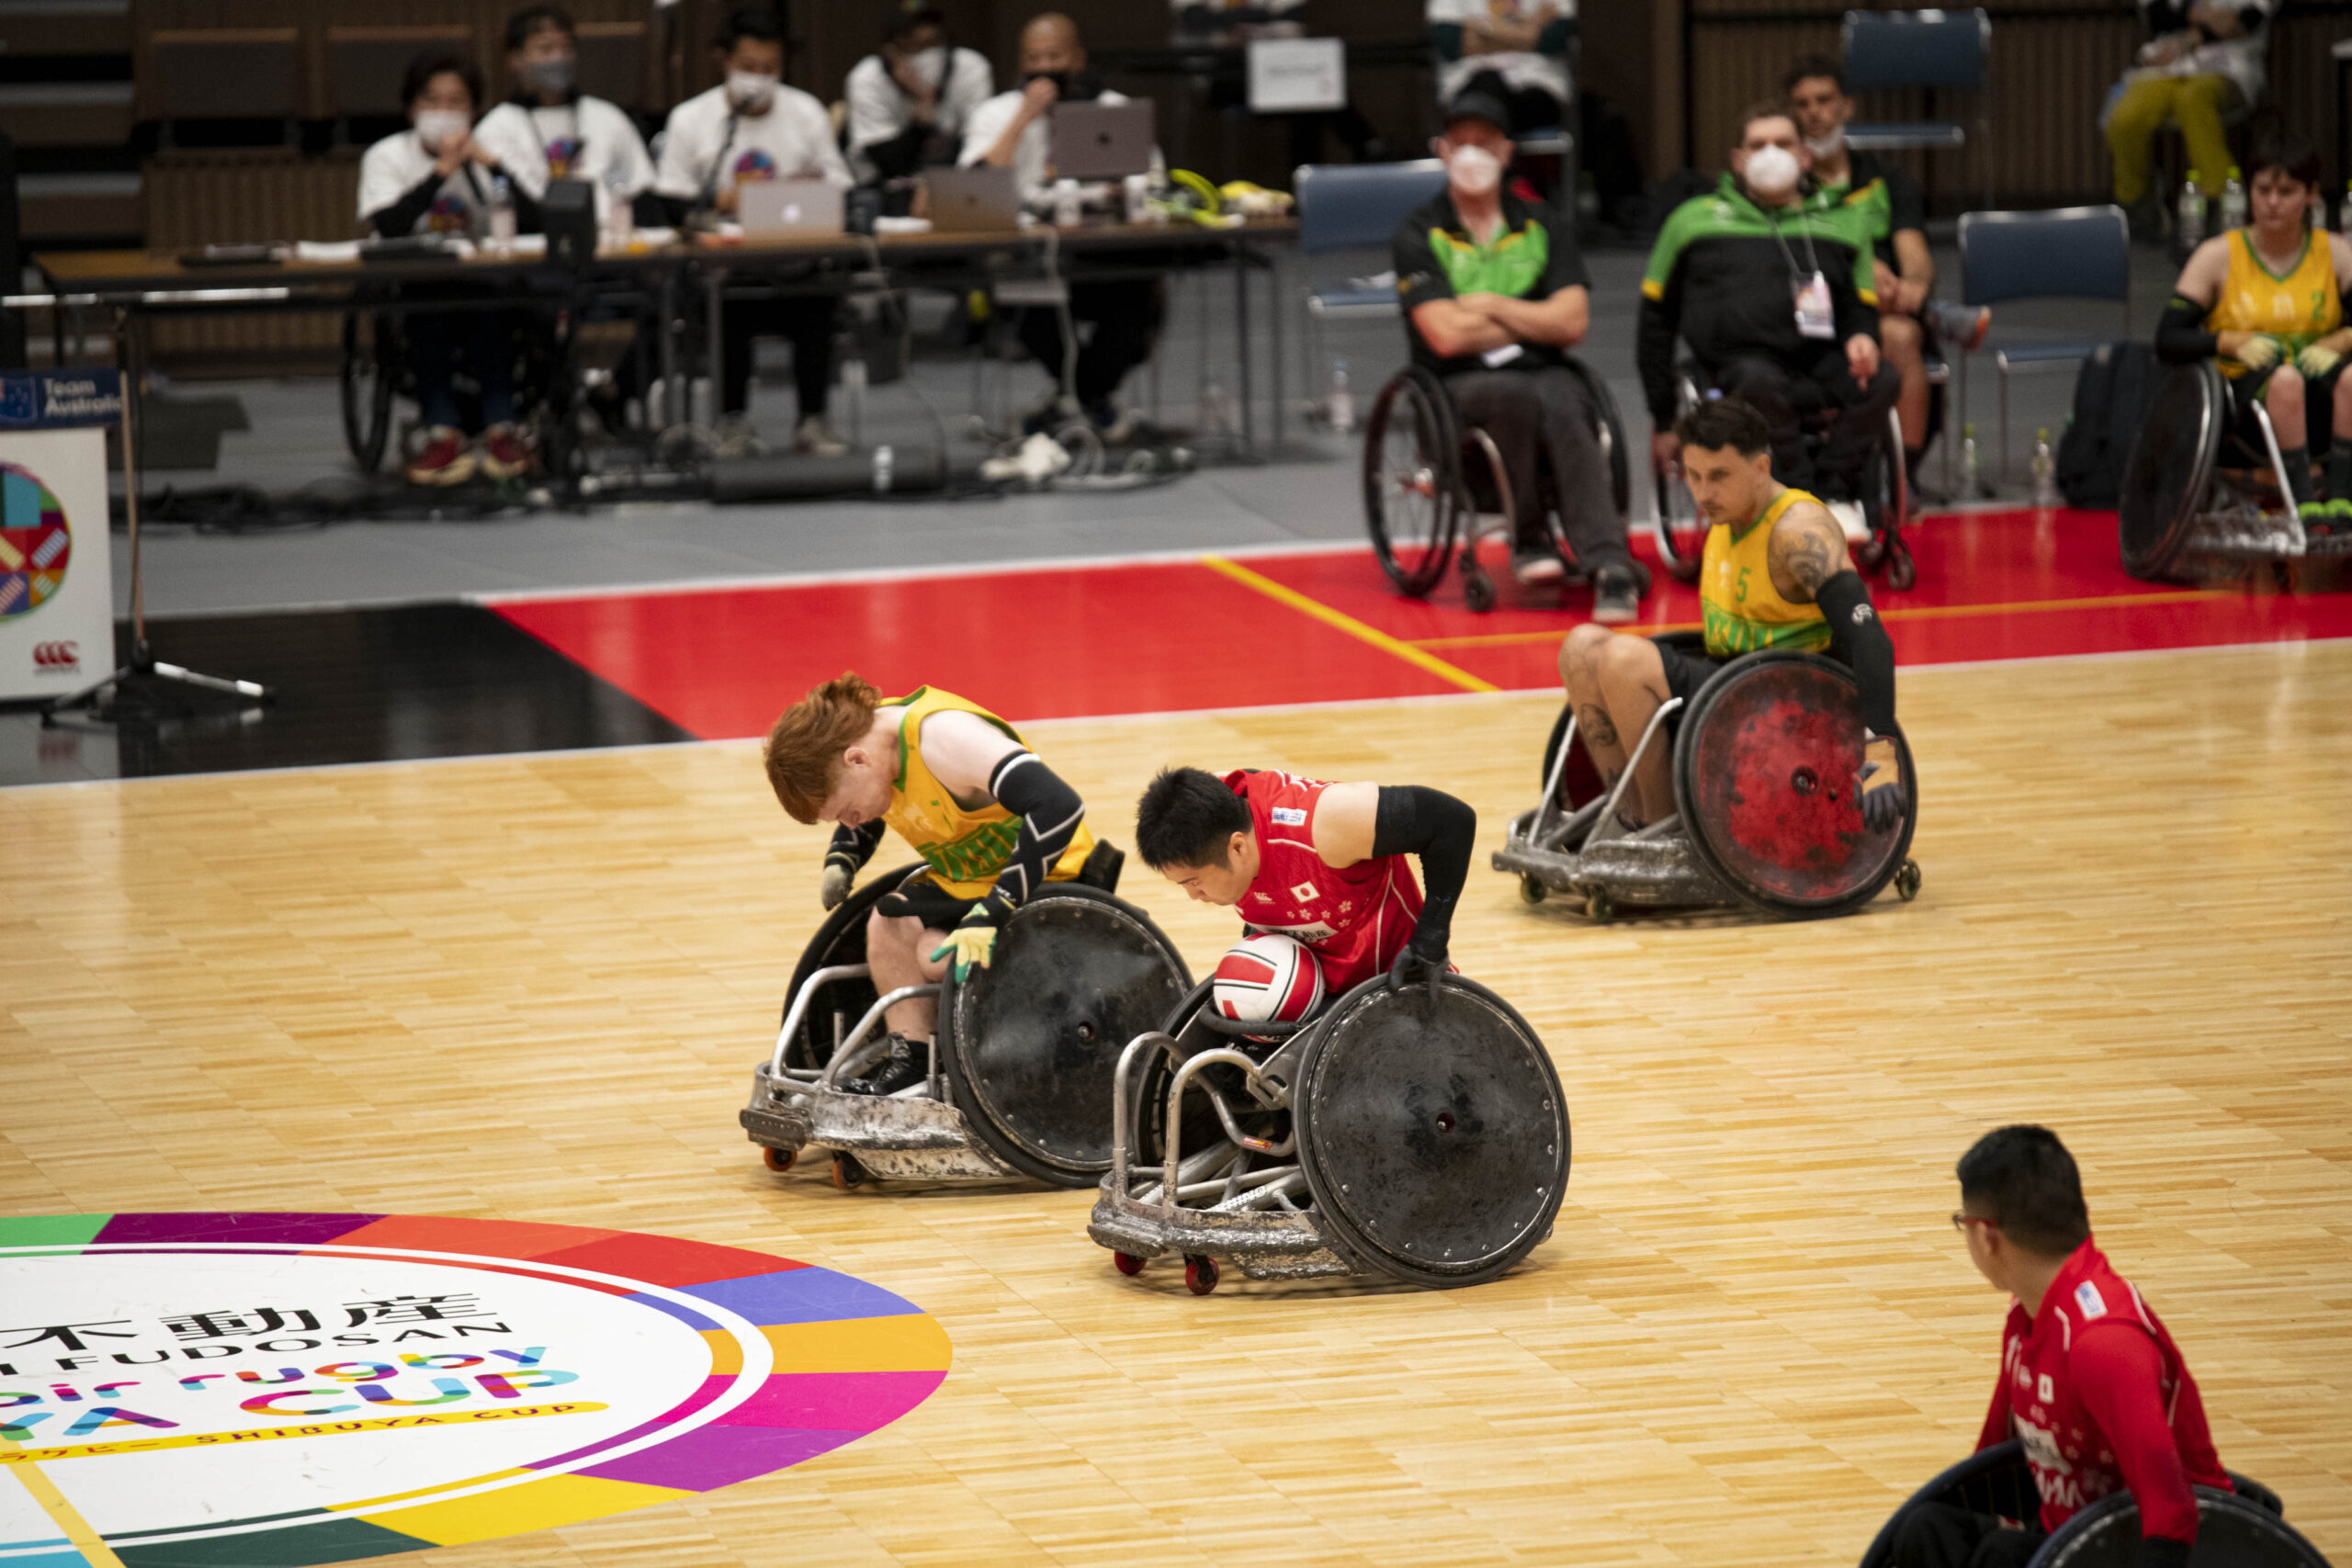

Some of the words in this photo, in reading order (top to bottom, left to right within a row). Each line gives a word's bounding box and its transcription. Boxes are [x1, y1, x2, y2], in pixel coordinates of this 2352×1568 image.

[43, 378, 96, 396] Team
[1735, 567, 1751, 603] 5
[55, 1322, 513, 1371] FUDOSAN
[179, 1347, 547, 1391] rugby
[240, 1370, 580, 1416] CUP
[196, 1416, 444, 1444] SHIBUYA
[473, 1404, 575, 1419] CUP
